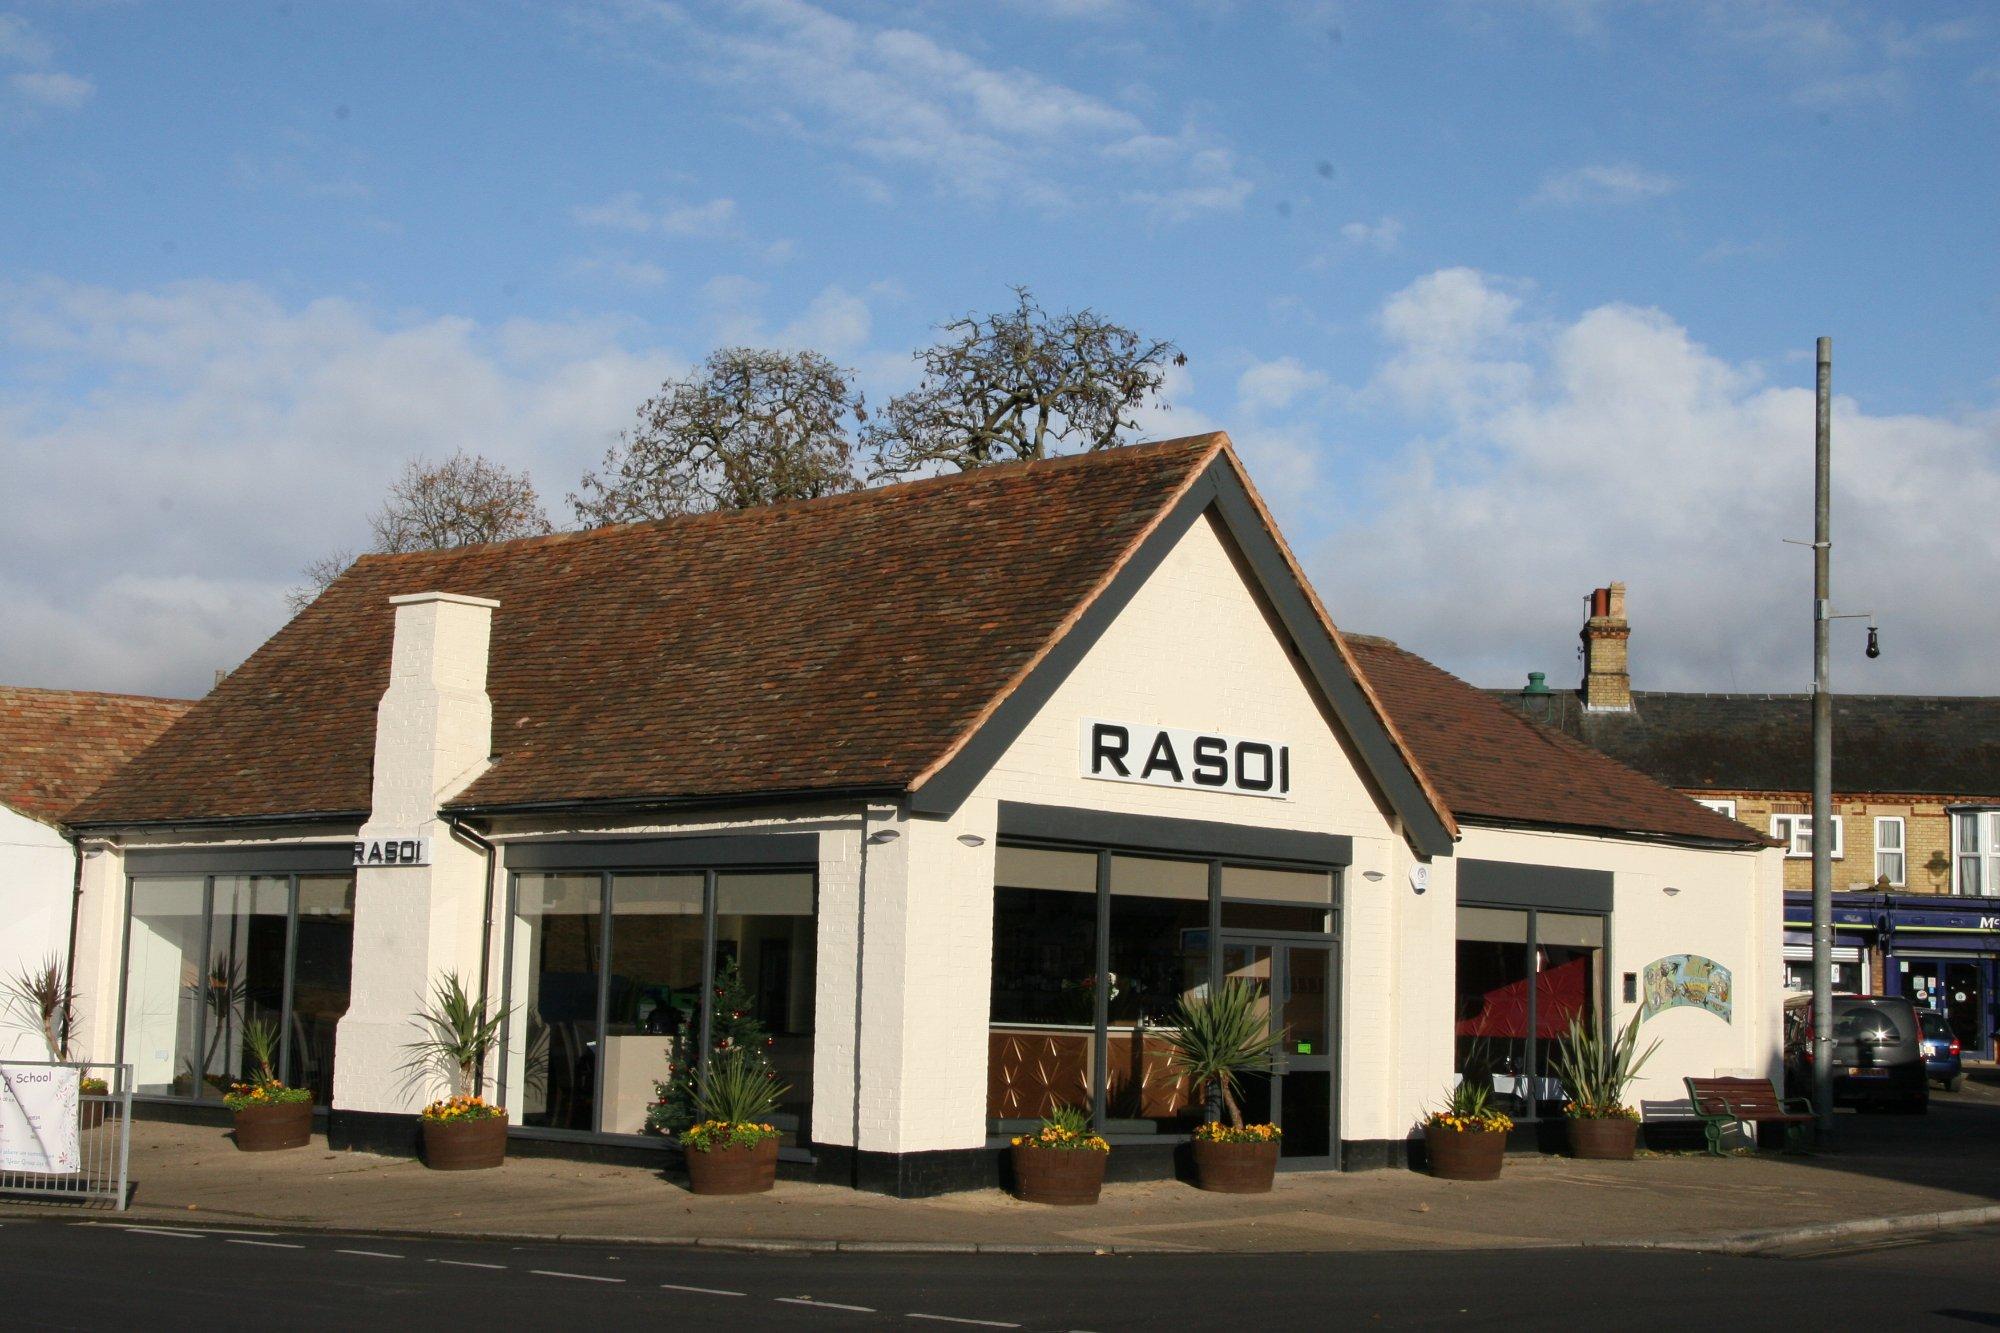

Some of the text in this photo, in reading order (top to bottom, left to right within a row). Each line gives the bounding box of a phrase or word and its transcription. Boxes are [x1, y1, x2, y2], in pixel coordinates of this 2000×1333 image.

[1092, 723, 1289, 793] RASOI
[352, 841, 420, 864] RASOI
[15, 1071, 52, 1084] School
